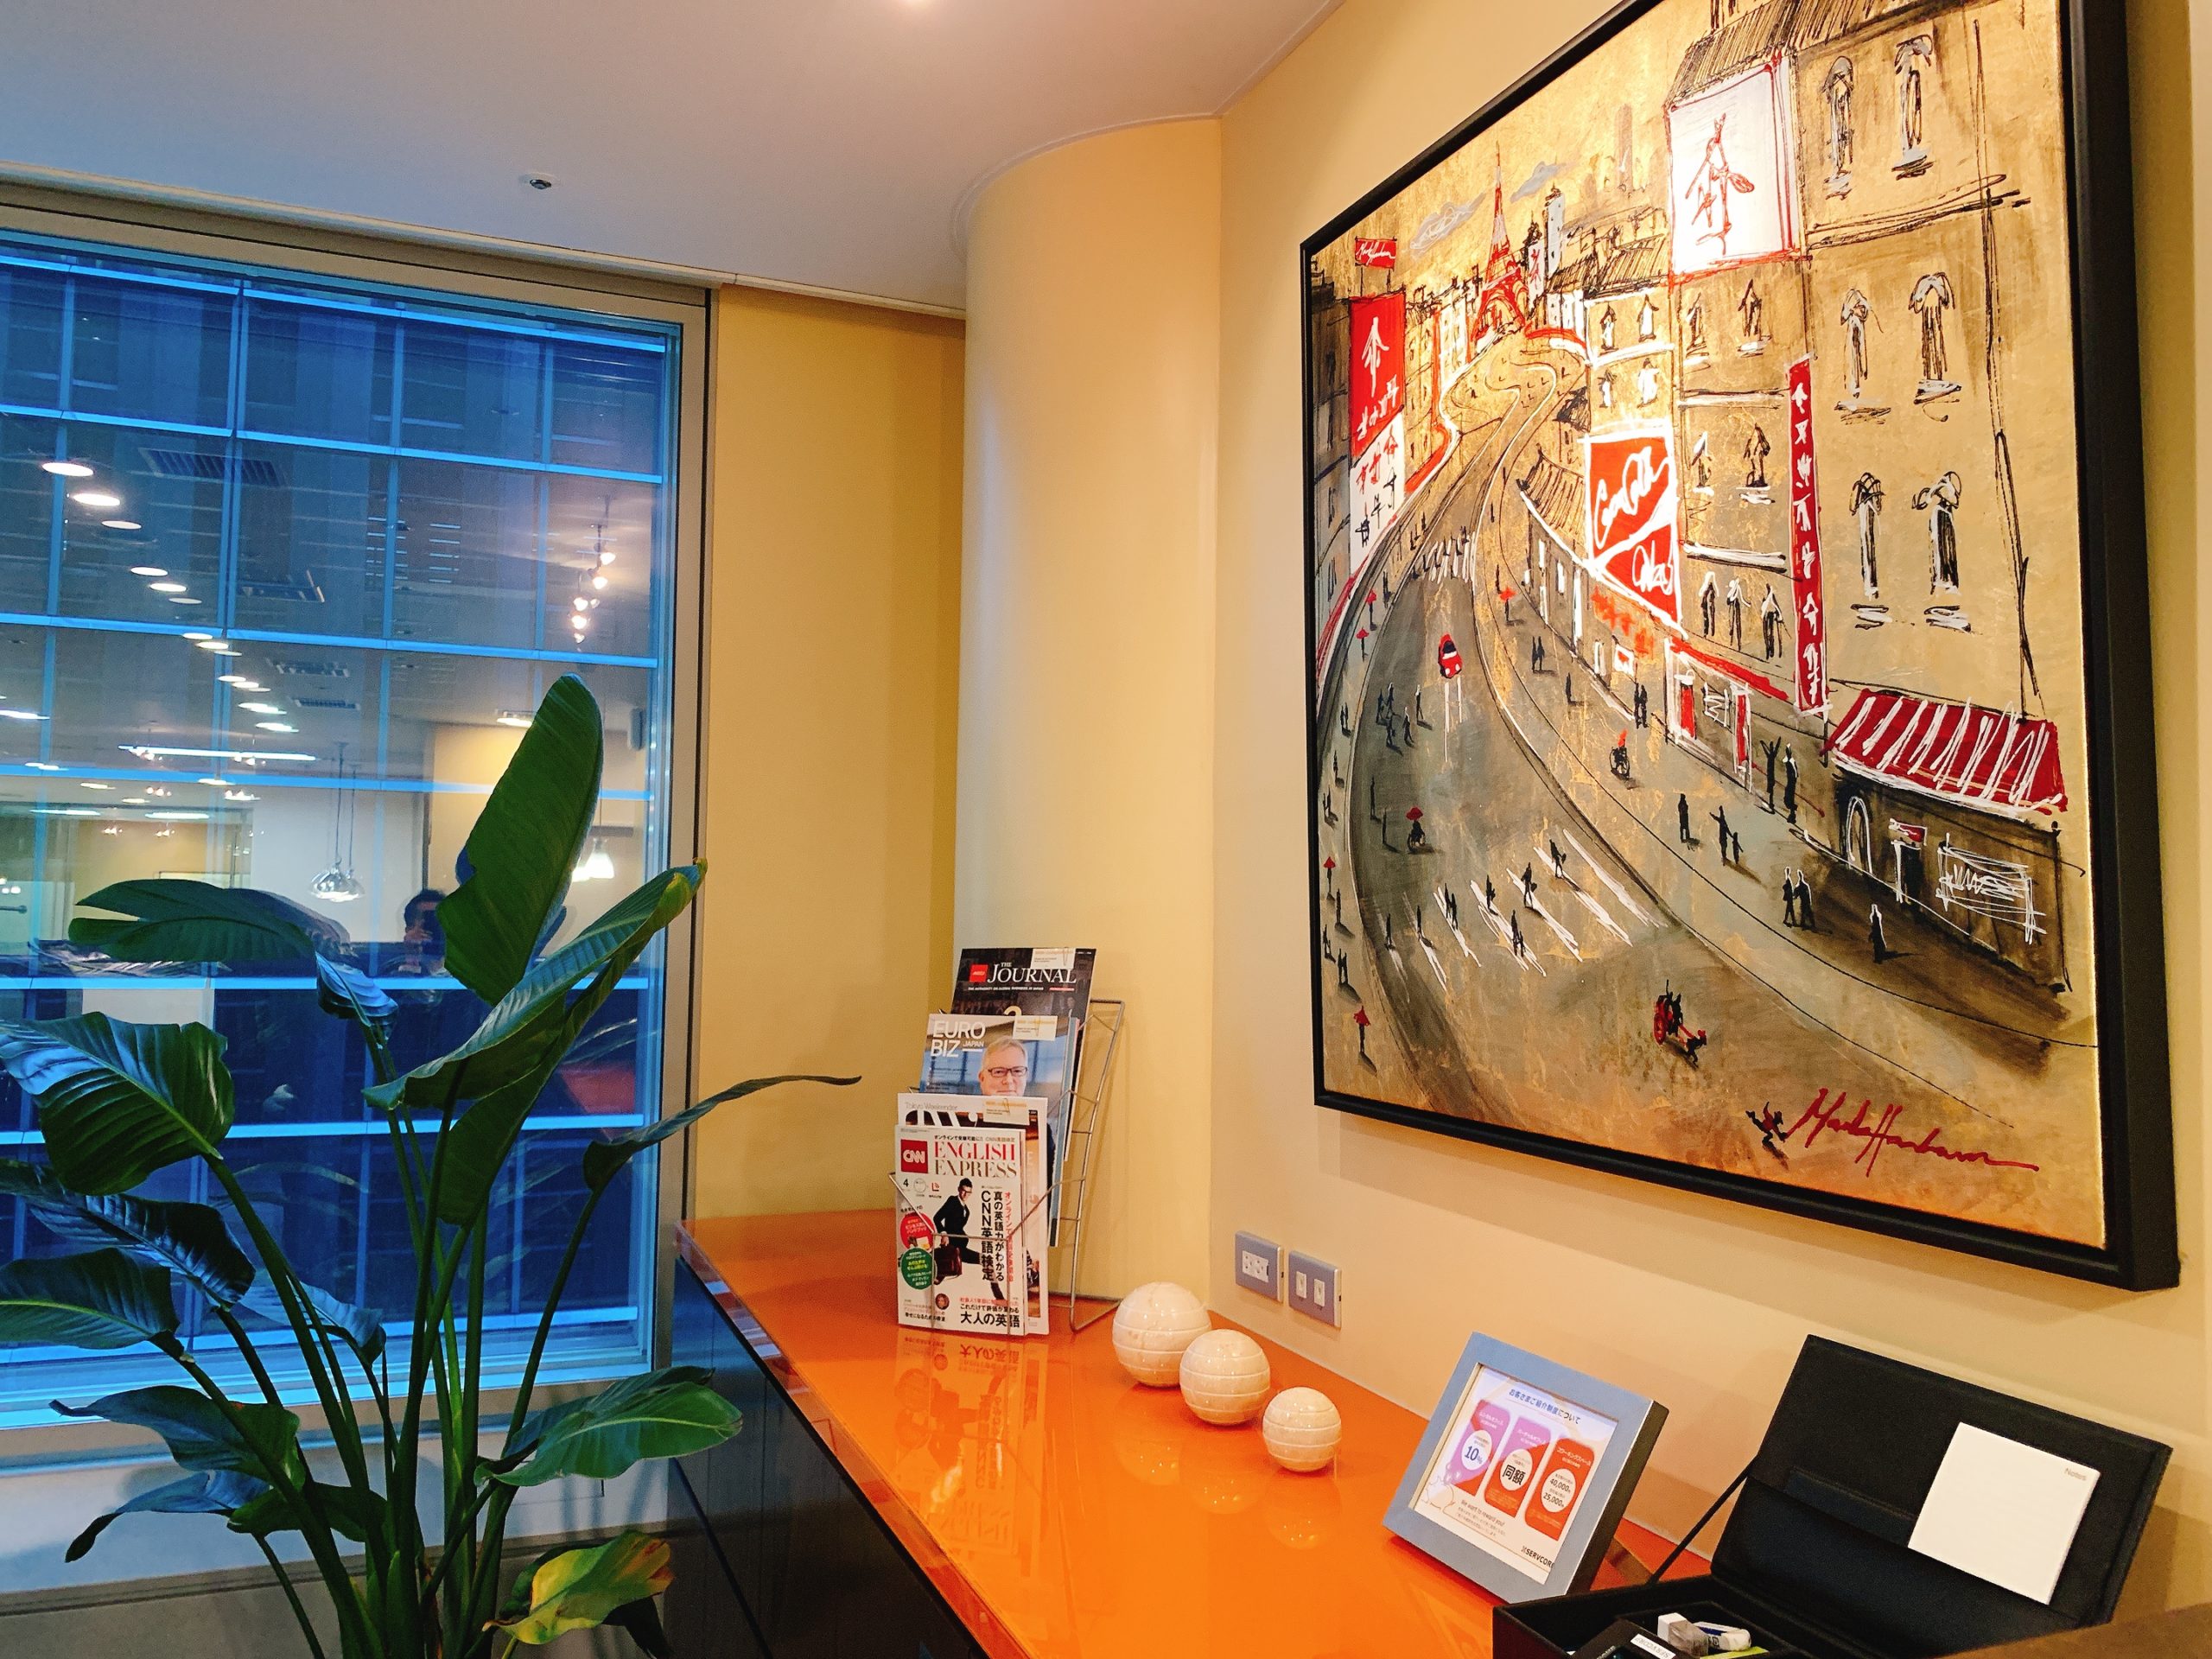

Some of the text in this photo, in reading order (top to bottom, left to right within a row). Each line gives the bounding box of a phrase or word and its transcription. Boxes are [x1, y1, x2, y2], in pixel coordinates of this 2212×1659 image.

[988, 963, 1077, 984] JOURNAL
[932, 1020, 986, 1039] EURO
[931, 1039, 961, 1058] BIZ
[924, 1103, 958, 1111] Weekender
[903, 1150, 925, 1164] CNN
[934, 1141, 1015, 1160] ENGLISH
[935, 1160, 1018, 1179] EXPRESS
[903, 1179, 909, 1187] 4
[982, 1190, 994, 1281] CNN英語検定
[994, 1192, 1004, 1281] 真の英語力がわかる
[961, 1311, 1020, 1328] 大人の英語
[1503, 1465, 1527, 1485] 同額
